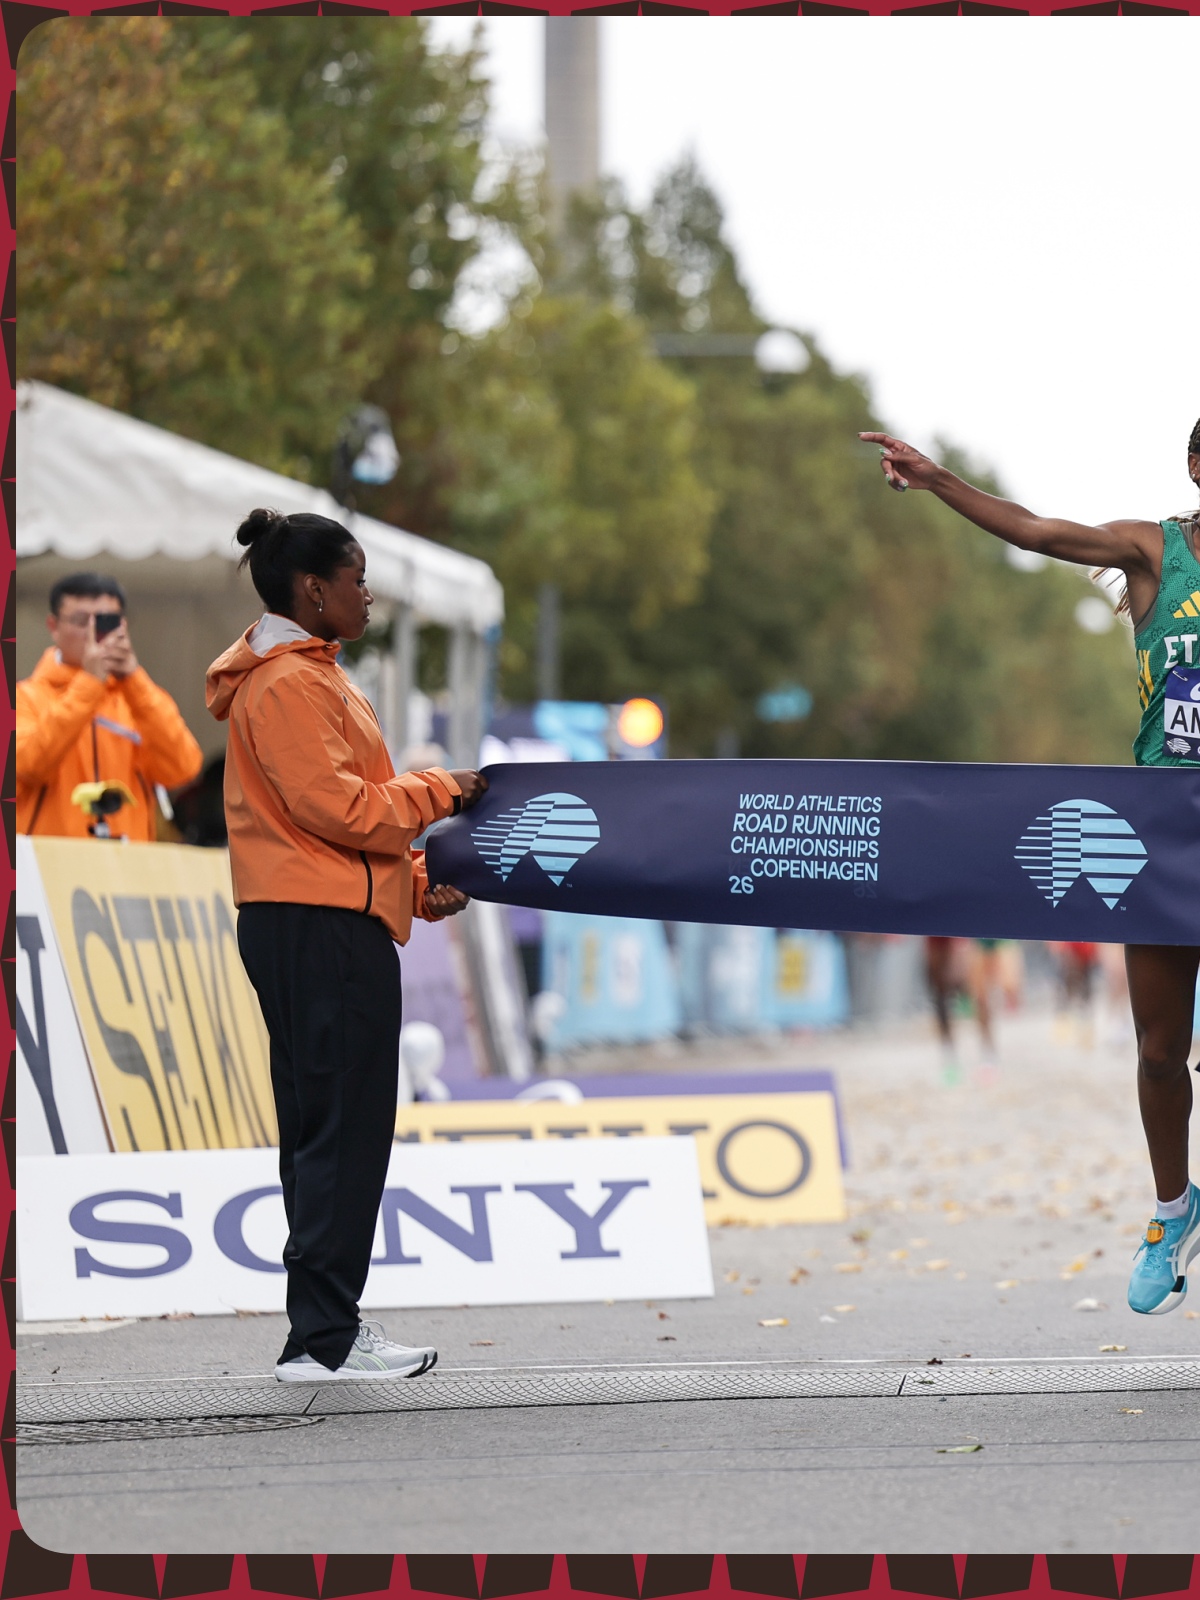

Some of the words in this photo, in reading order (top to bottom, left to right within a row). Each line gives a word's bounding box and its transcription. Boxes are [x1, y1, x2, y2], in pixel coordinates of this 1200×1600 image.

[739, 794, 794, 810] WORLD
[796, 795, 882, 813] ATHLETICS
[733, 813, 787, 833] ROAD
[792, 815, 881, 836] RUNNING
[731, 836, 879, 858] CHAMPIONSHIPS
[750, 858, 878, 881] COPENHAGEN
[729, 876, 754, 894] 26
